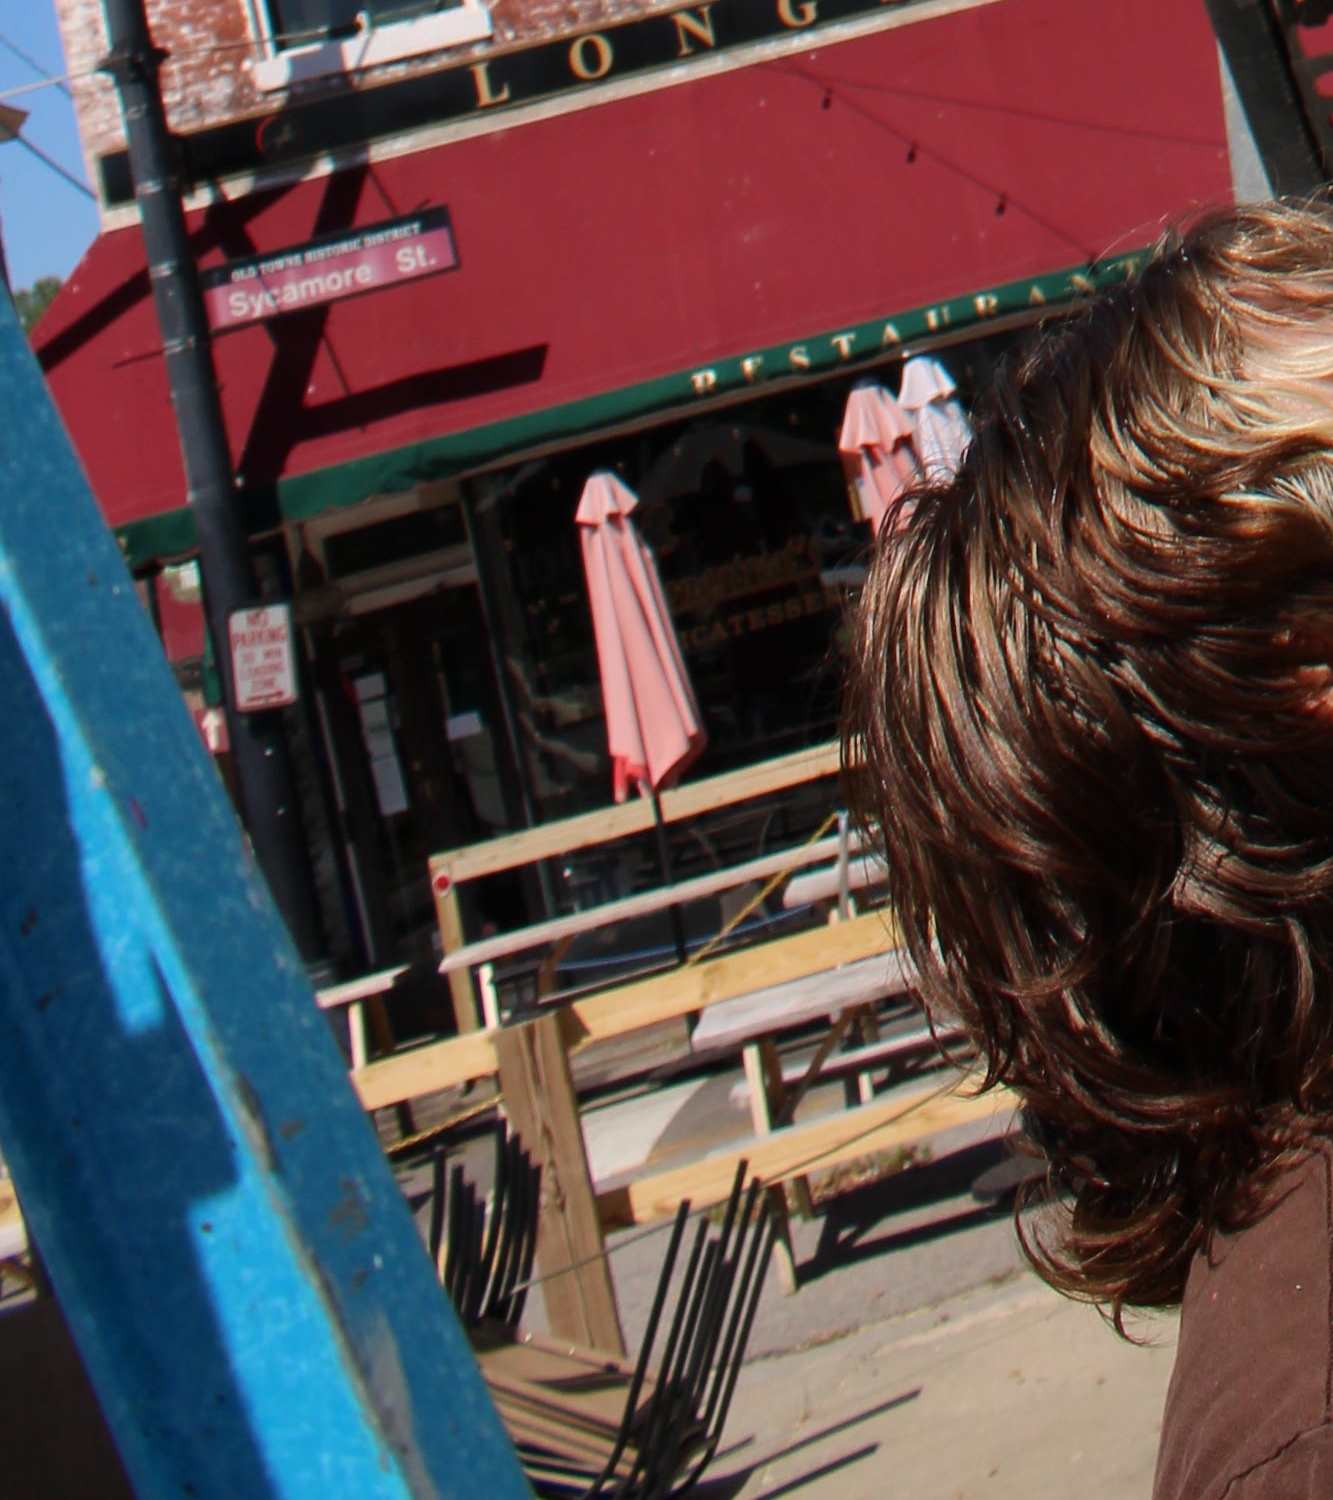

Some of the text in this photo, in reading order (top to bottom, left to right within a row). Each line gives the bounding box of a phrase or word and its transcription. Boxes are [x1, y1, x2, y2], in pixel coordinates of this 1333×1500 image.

[363, 222, 420, 247] DISTRICT
[228, 245, 437, 318] Sycamore St.
